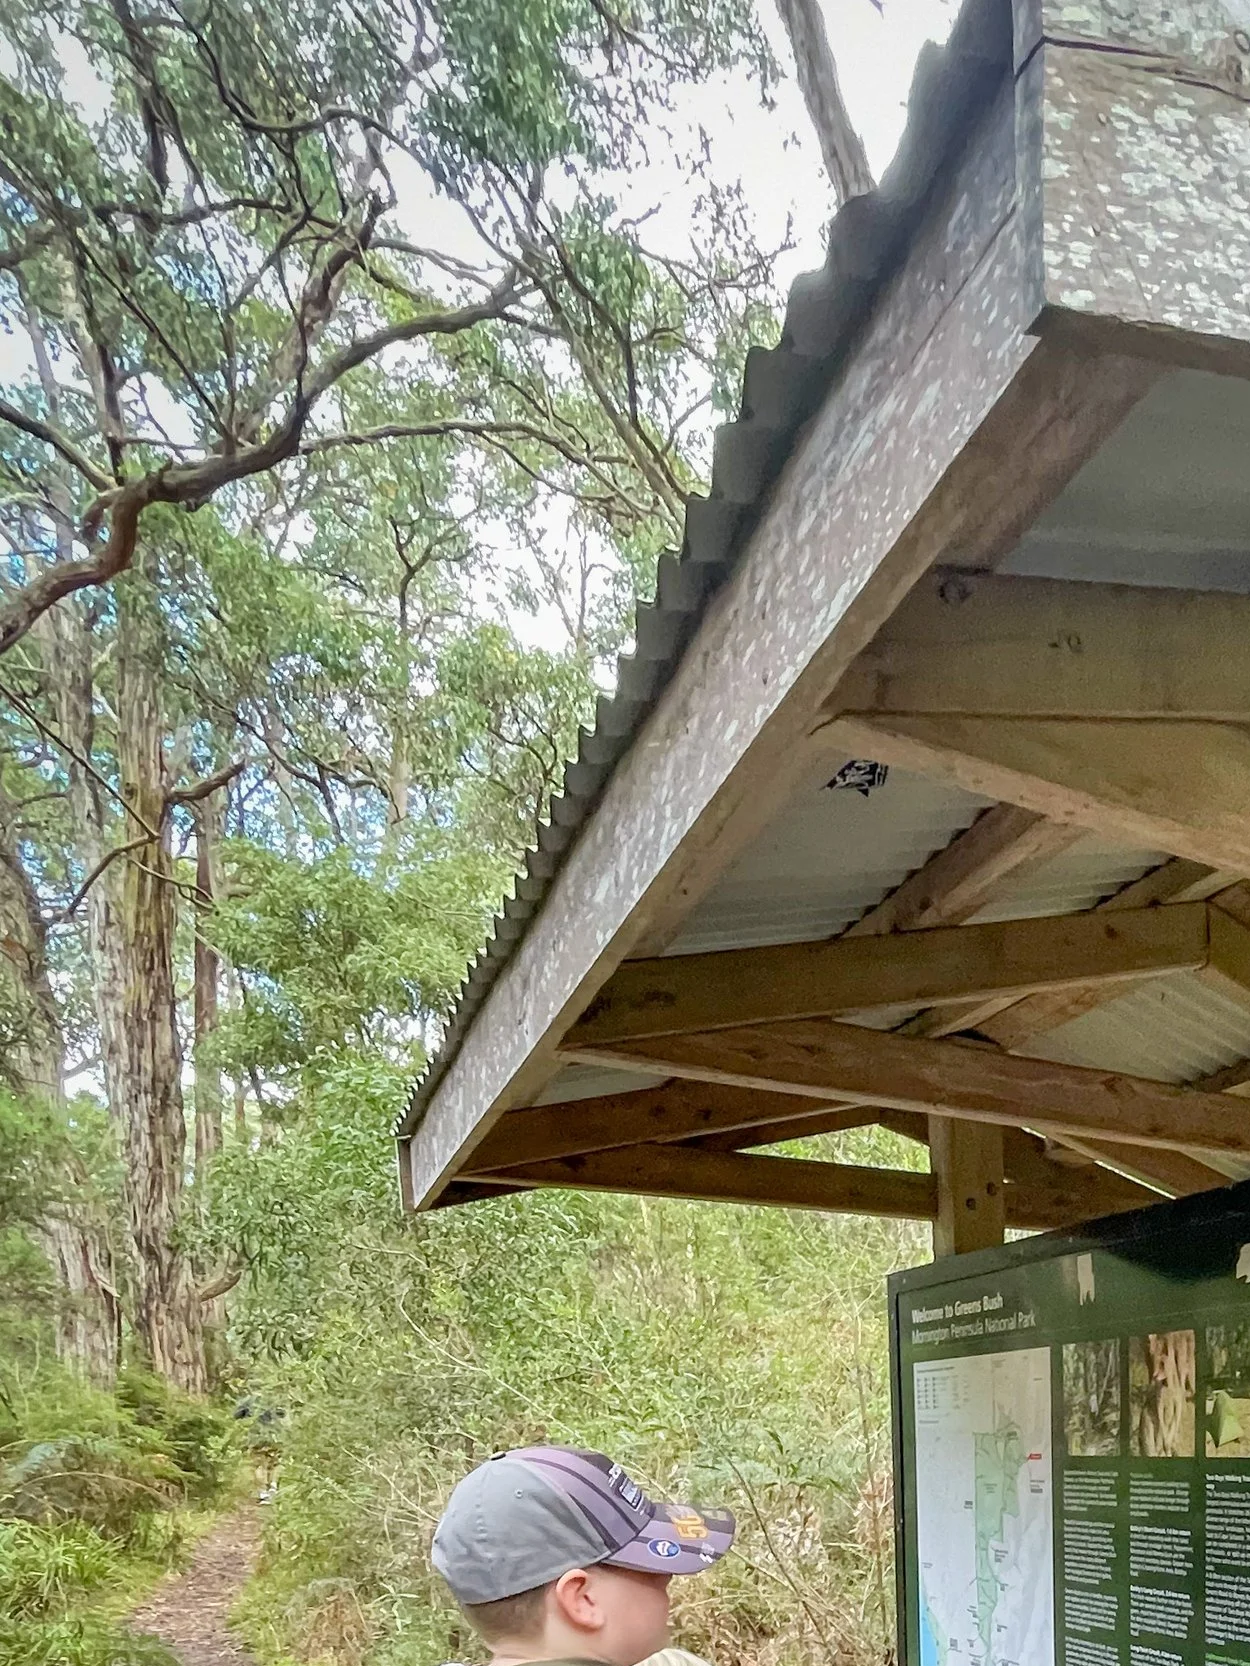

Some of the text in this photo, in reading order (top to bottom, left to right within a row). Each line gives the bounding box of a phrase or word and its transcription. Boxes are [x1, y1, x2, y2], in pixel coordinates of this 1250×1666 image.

[912, 1292, 1003, 1324] Welcome to Greens Bush
[951, 1321, 983, 1338] Peninsula
[985, 1312, 1016, 1333] National
[1018, 1309, 1036, 1327] Park
